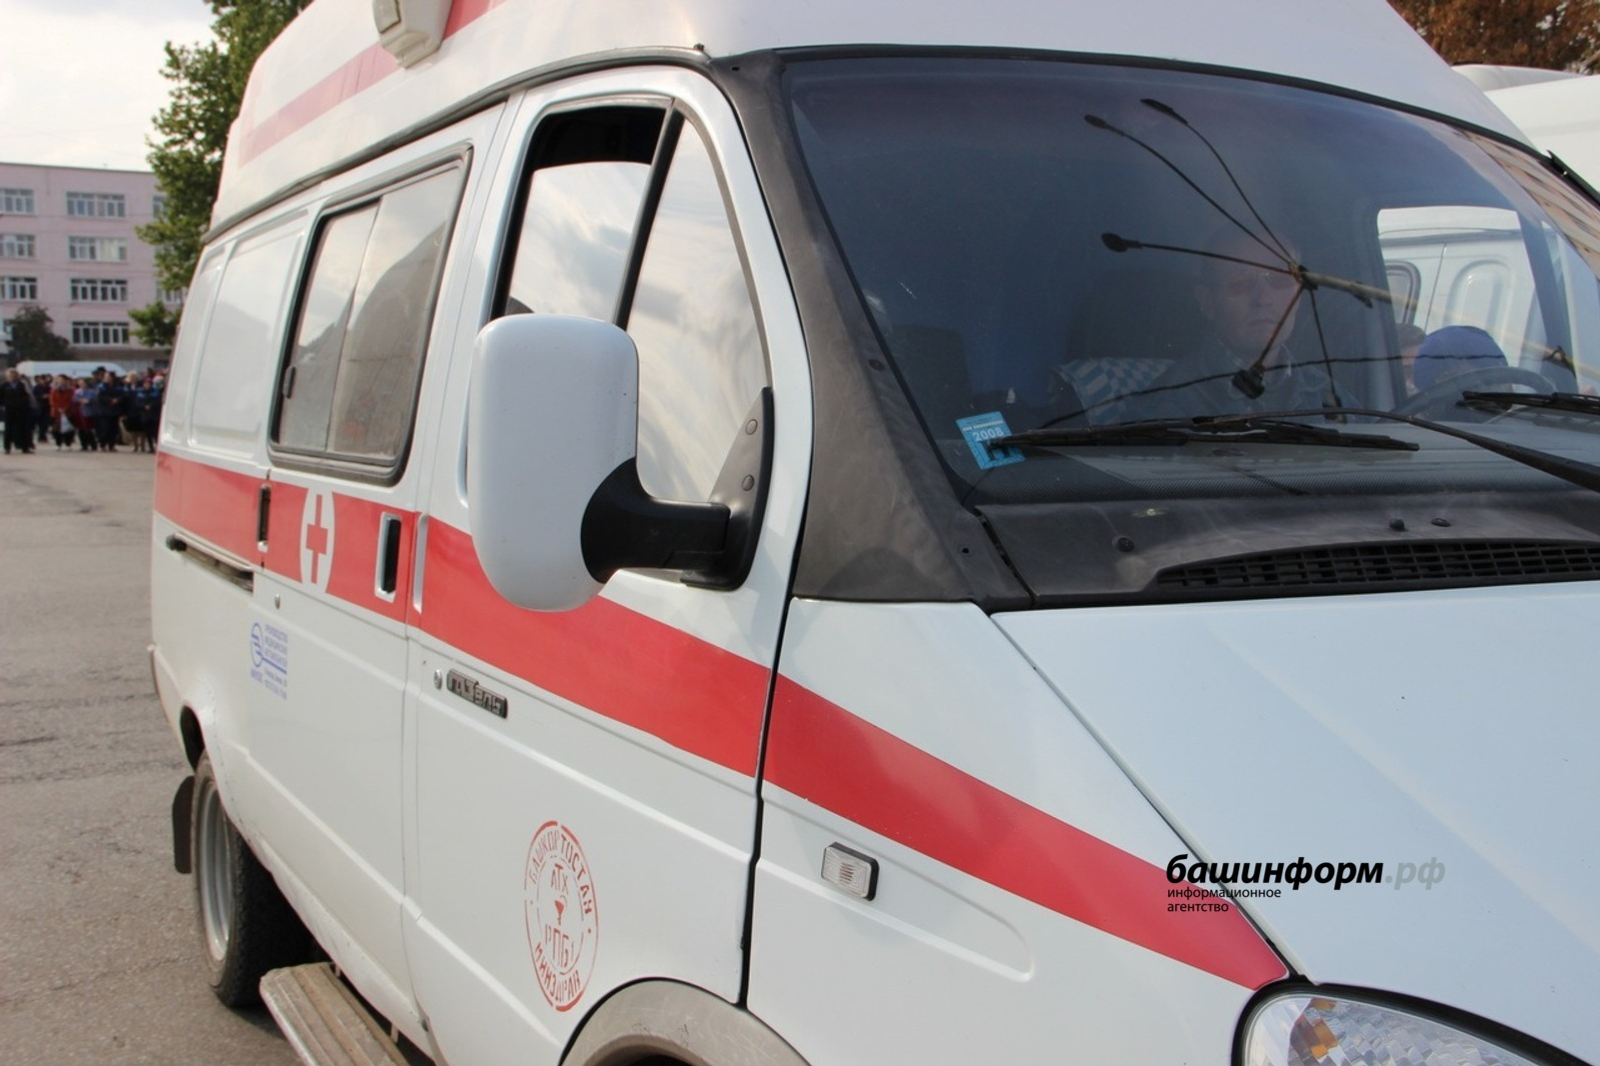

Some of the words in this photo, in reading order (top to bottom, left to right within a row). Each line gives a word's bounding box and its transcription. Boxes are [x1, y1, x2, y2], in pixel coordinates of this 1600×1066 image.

[973, 427, 1004, 442] 2008
[529, 830, 592, 914] БАШКОРТОСТАН
[551, 863, 568, 895] АТХ
